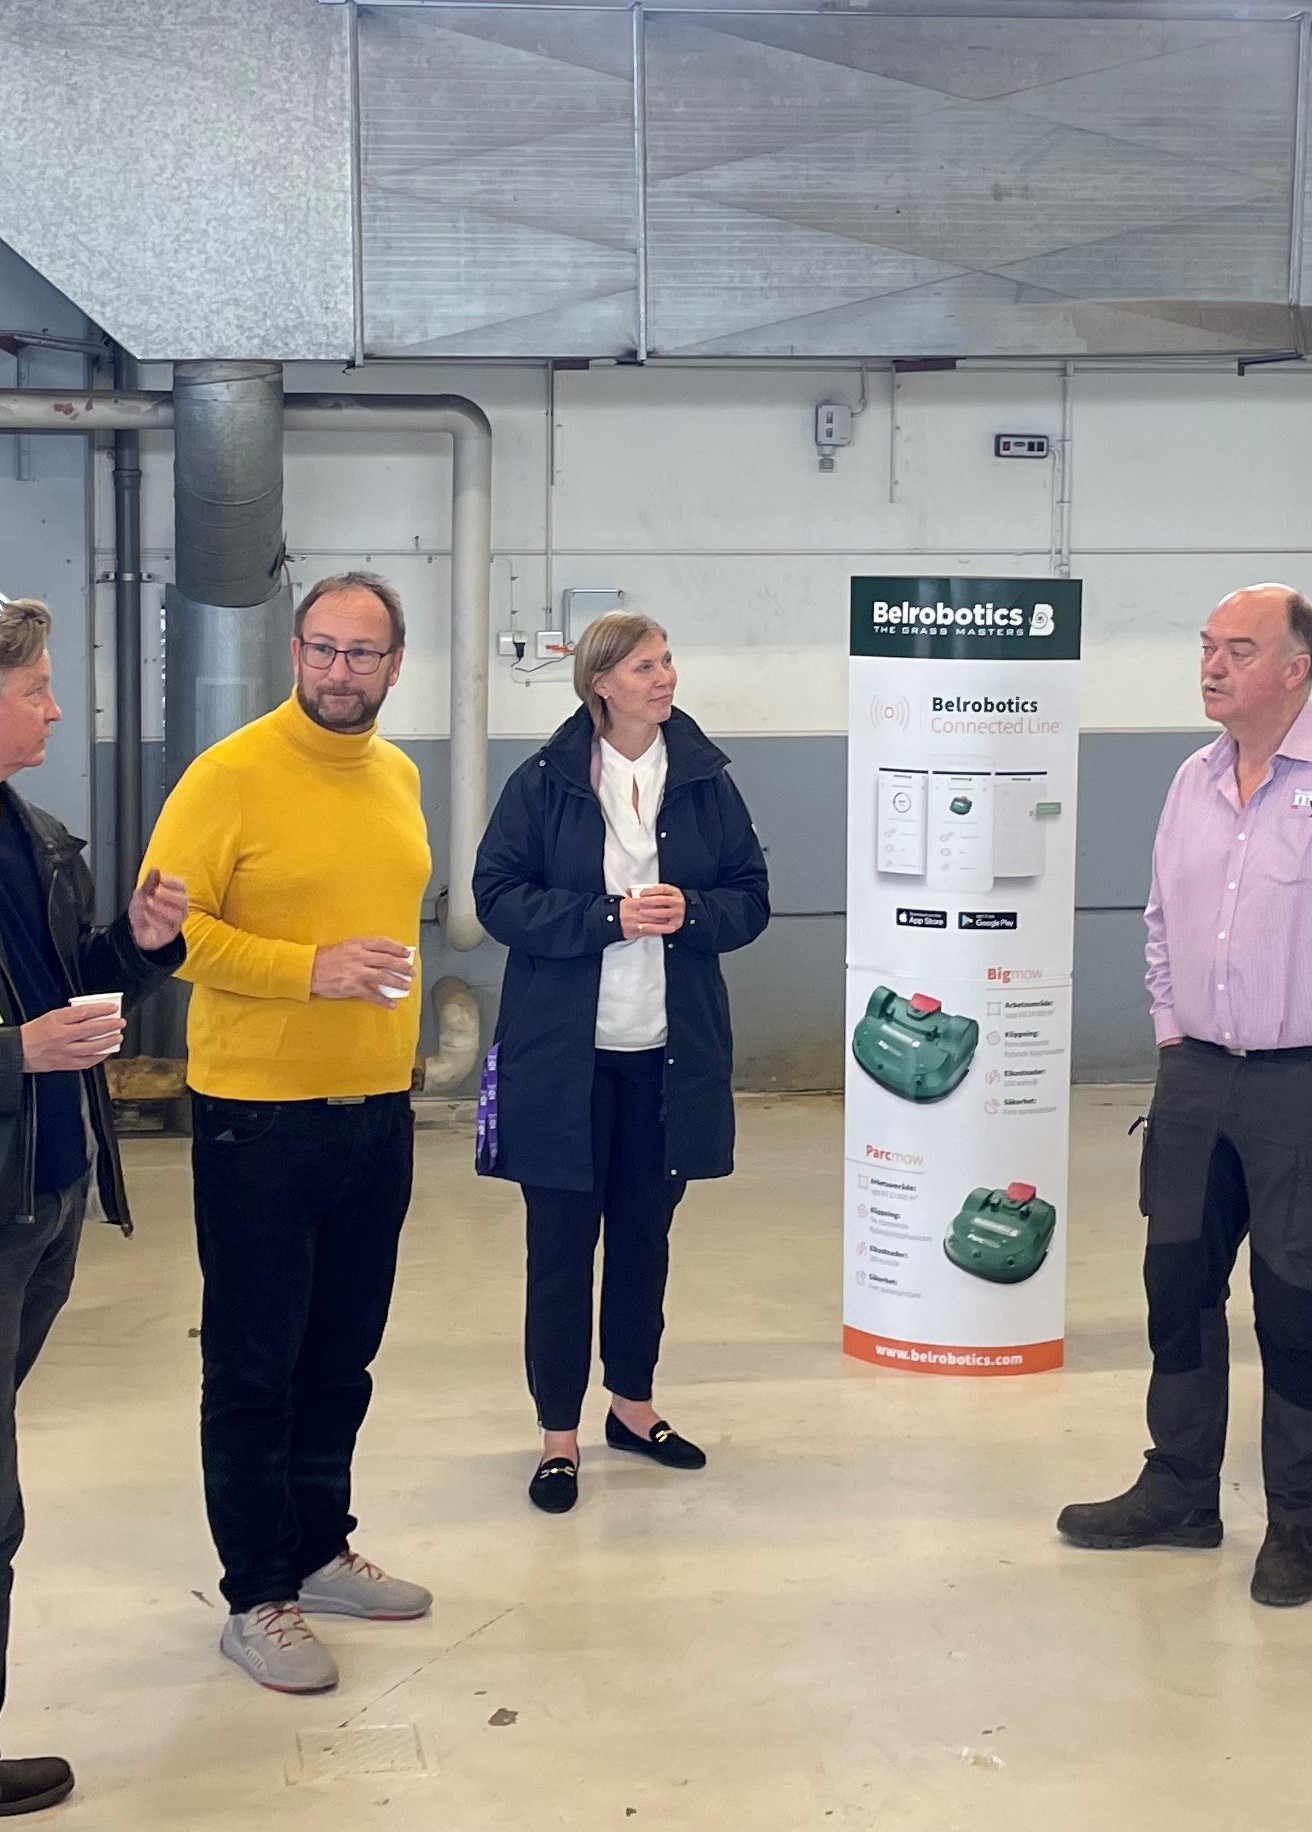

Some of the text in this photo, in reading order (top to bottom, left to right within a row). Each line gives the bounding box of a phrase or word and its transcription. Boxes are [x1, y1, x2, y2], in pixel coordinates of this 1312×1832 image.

[873, 601, 1024, 626] Belrobotics
[873, 625, 1024, 637] THE GRASS MASTERS
[932, 696, 1038, 713] Belrobotics
[931, 716, 1060, 734] Connected Line
[987, 966, 1042, 984] Bigmow
[865, 1144, 924, 1166] Parcmow
[875, 1344, 1024, 1366] www.belrobotics.com
